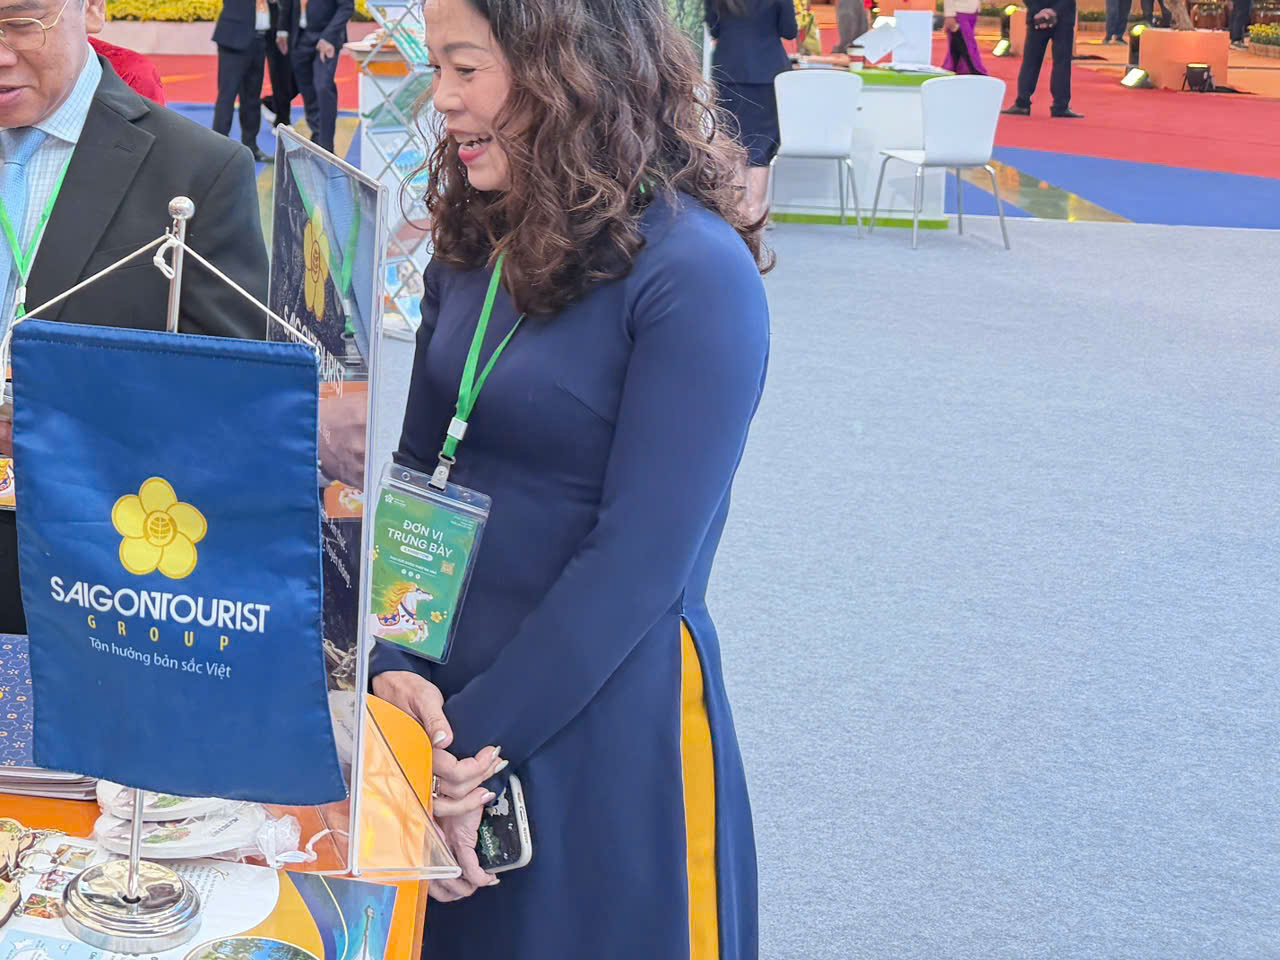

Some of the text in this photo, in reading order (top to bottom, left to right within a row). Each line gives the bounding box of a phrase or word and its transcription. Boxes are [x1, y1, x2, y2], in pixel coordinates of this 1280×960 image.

[388, 528, 428, 548] TRƯNG
[429, 542, 453, 558] BÀY
[403, 520, 443, 543] ĐƠN VỊ
[50, 575, 270, 633] SAIGONTOURIST
[89, 636, 232, 680] Tận hưởng bản sắc Việt
